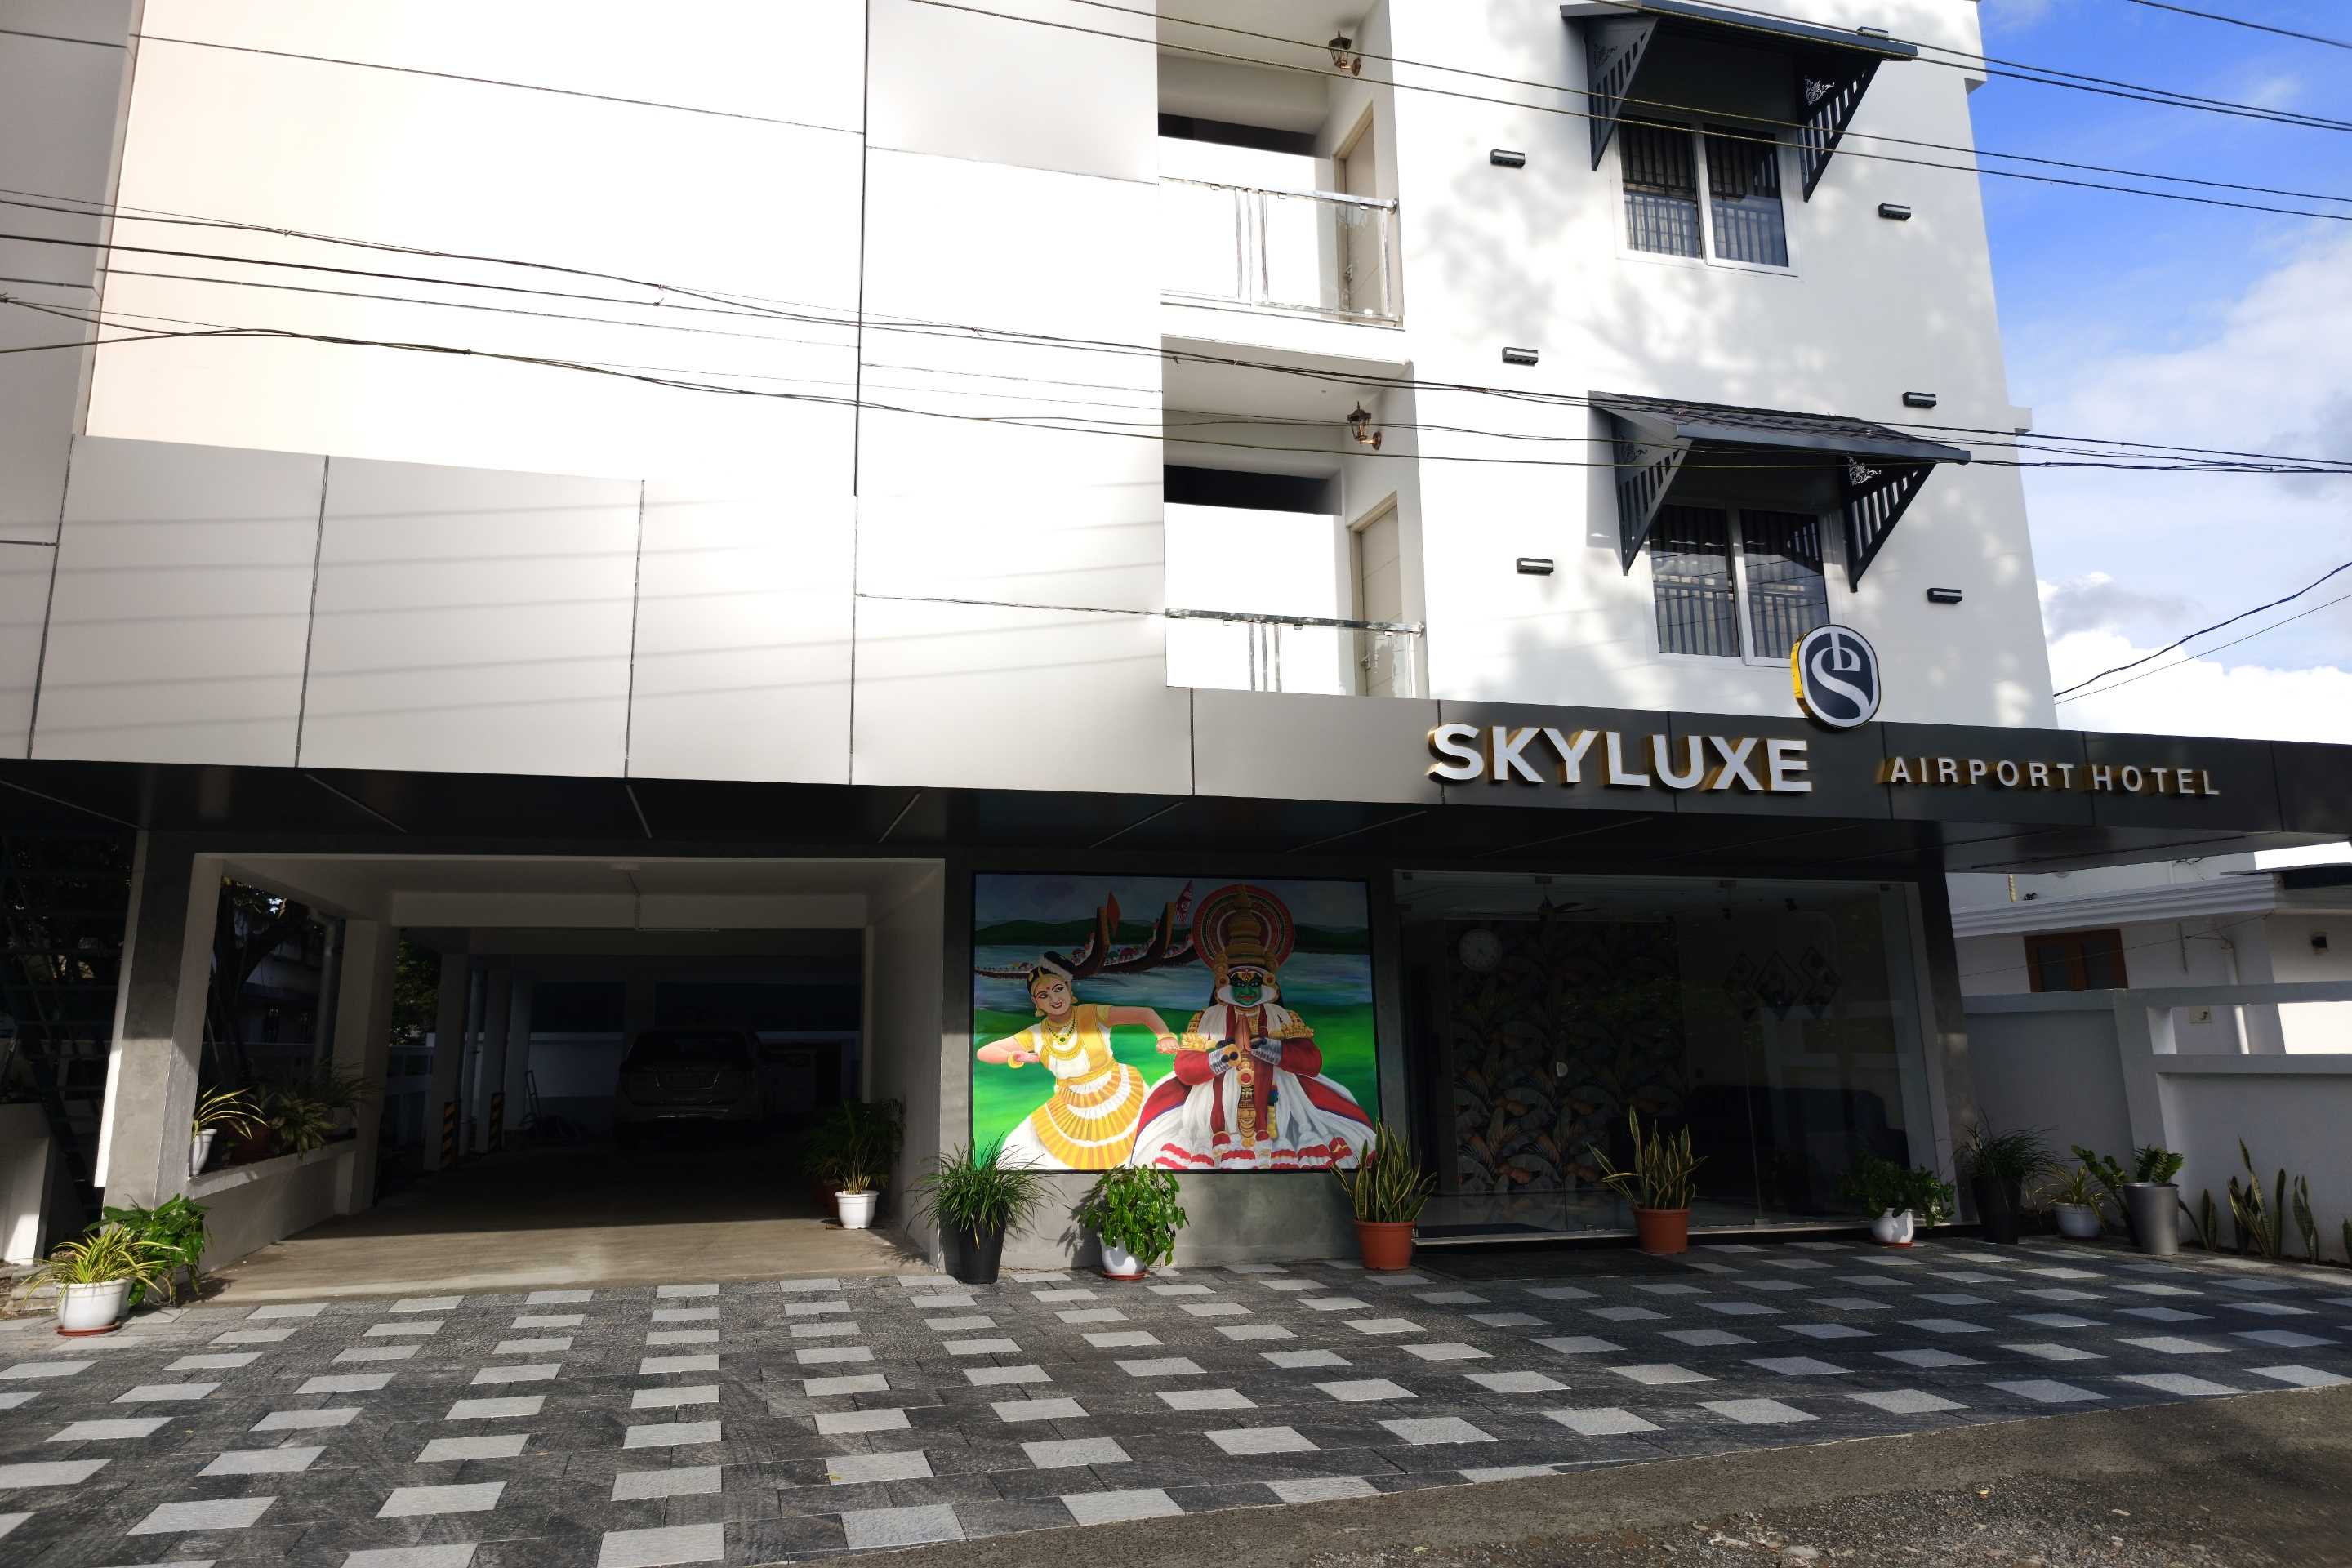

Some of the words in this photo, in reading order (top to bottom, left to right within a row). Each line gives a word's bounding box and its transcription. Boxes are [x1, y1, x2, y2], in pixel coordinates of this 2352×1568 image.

[1428, 722, 1813, 793] SKYLUXE
[1887, 756, 2074, 790] AIRPORT
[2092, 764, 2221, 795] HOTEL
